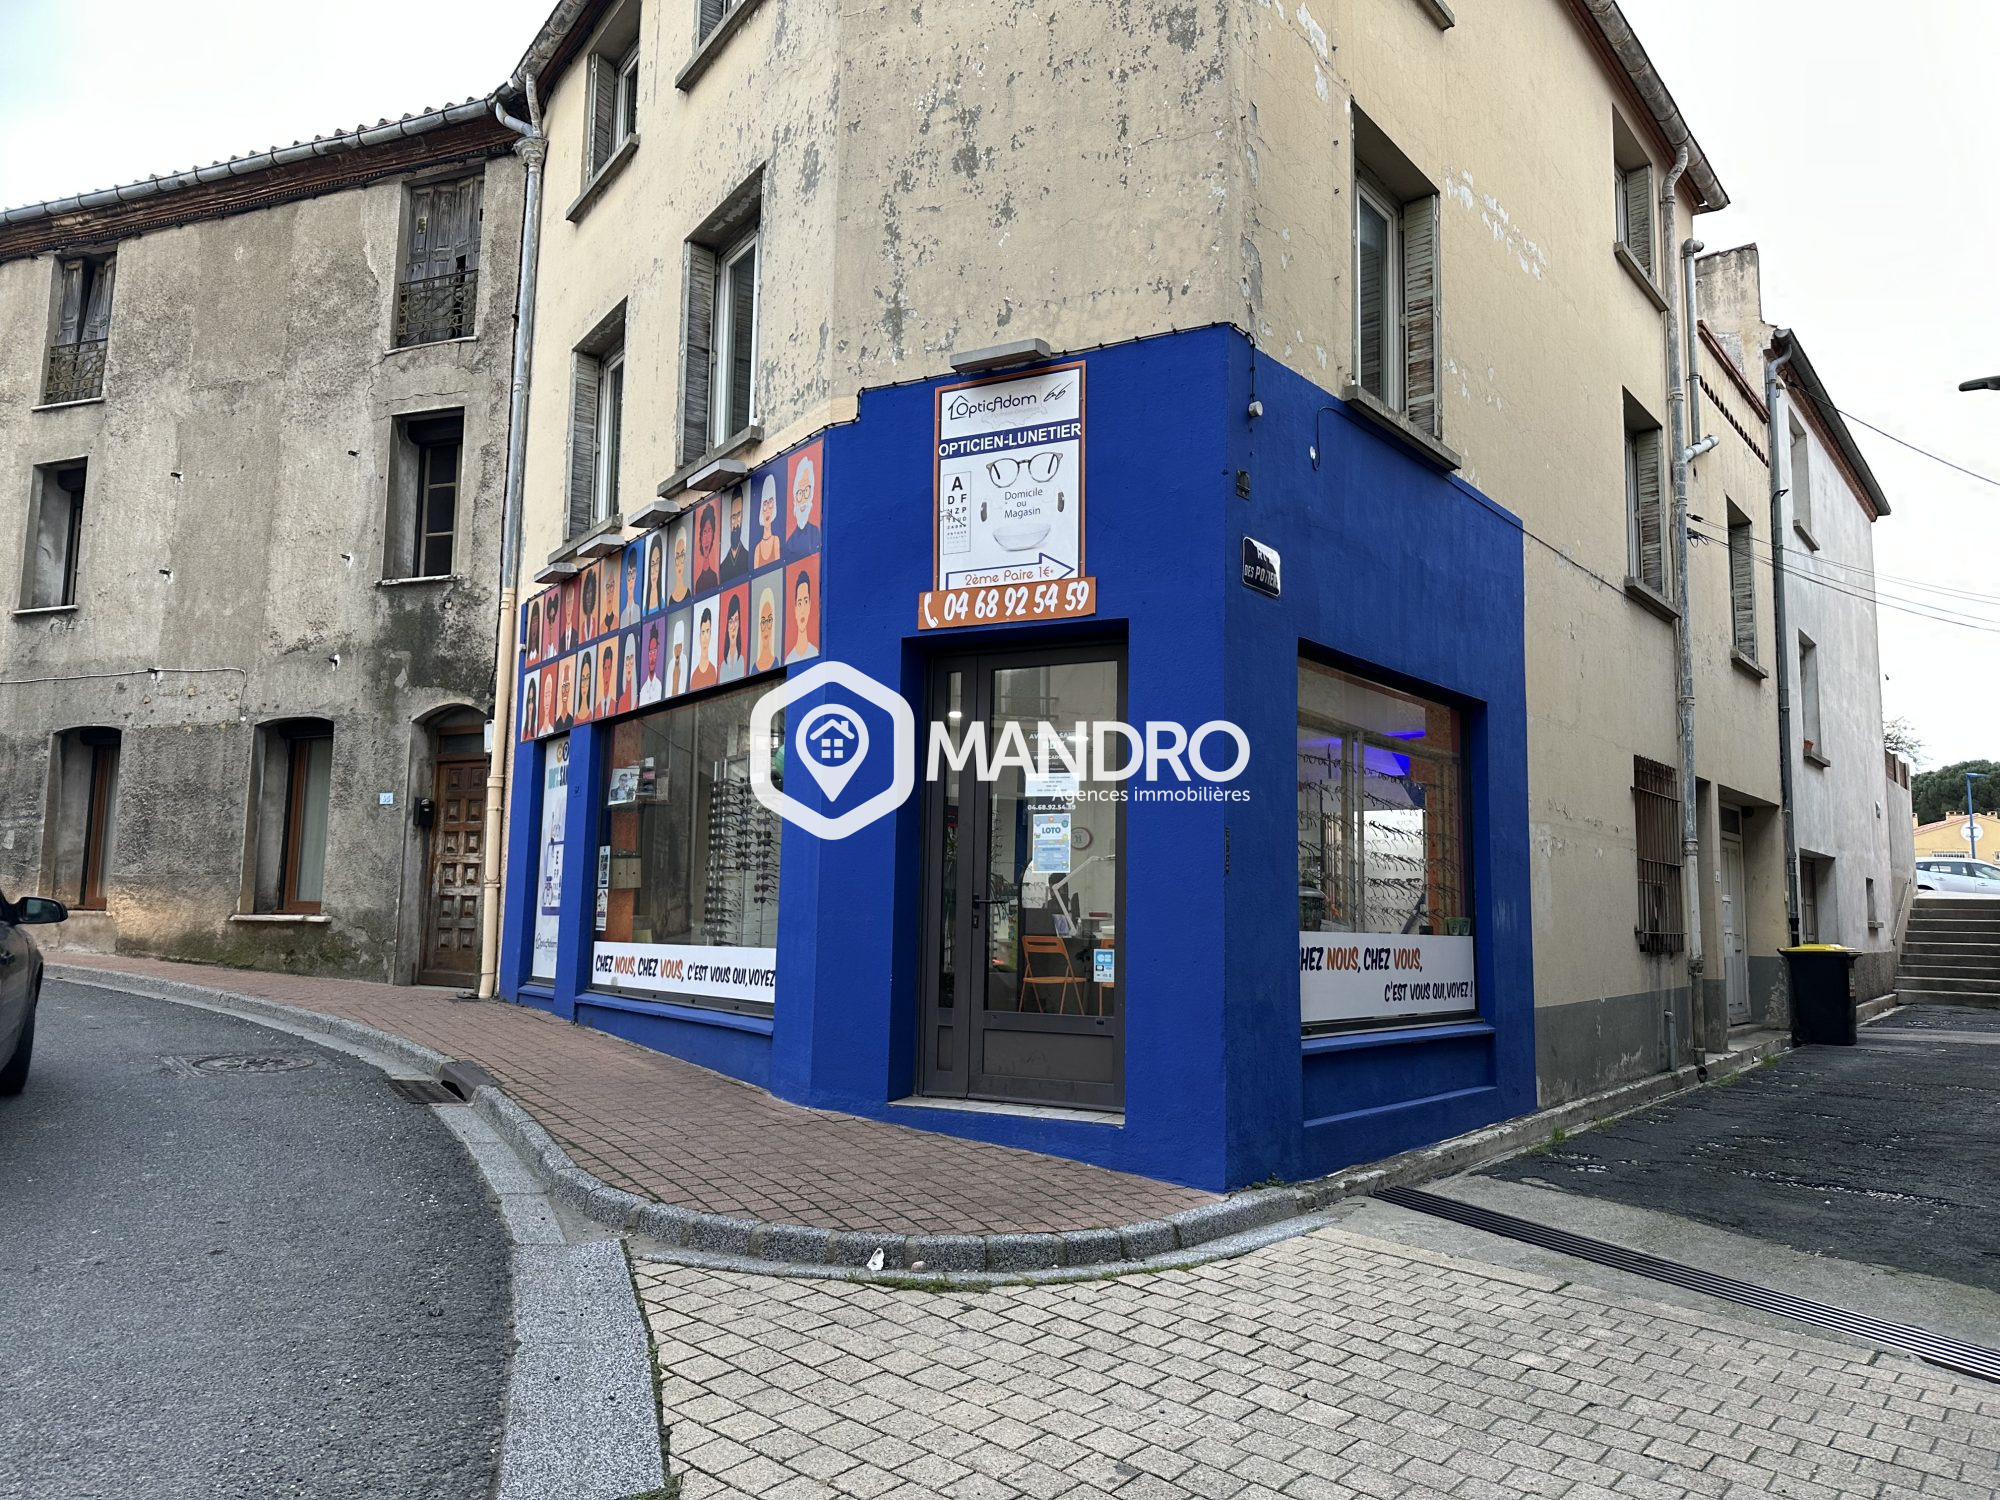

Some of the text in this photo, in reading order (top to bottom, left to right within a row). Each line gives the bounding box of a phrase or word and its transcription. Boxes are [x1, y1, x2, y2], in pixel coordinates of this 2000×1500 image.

[956, 395, 1036, 418] OpticAdom
[938, 423, 1081, 456] OPTICIEN-LUNETIER
[951, 476, 963, 491] A
[1005, 487, 1043, 501] Domicile
[1004, 507, 1041, 519] Magasin
[965, 572, 999, 586] 2ème
[1004, 569, 1033, 582] Paire
[1244, 564, 1254, 578] DES
[944, 580, 1089, 621] 04 68 92 54 59
[1041, 826, 1062, 834] LOTO
[595, 954, 614, 972] CHEZ
[614, 956, 636, 977] NOUS,
[637, 957, 658, 977] CHEZ
[660, 959, 684, 982] VOUS,
[687, 962, 709, 981] C'EST
[710, 965, 730, 983] VOUS
[1300, 946, 1422, 973] HEZ NOUS, CHEZ VOUS,
[1384, 981, 1407, 1002] C'EST
[1409, 982, 1430, 1000] VOUS
